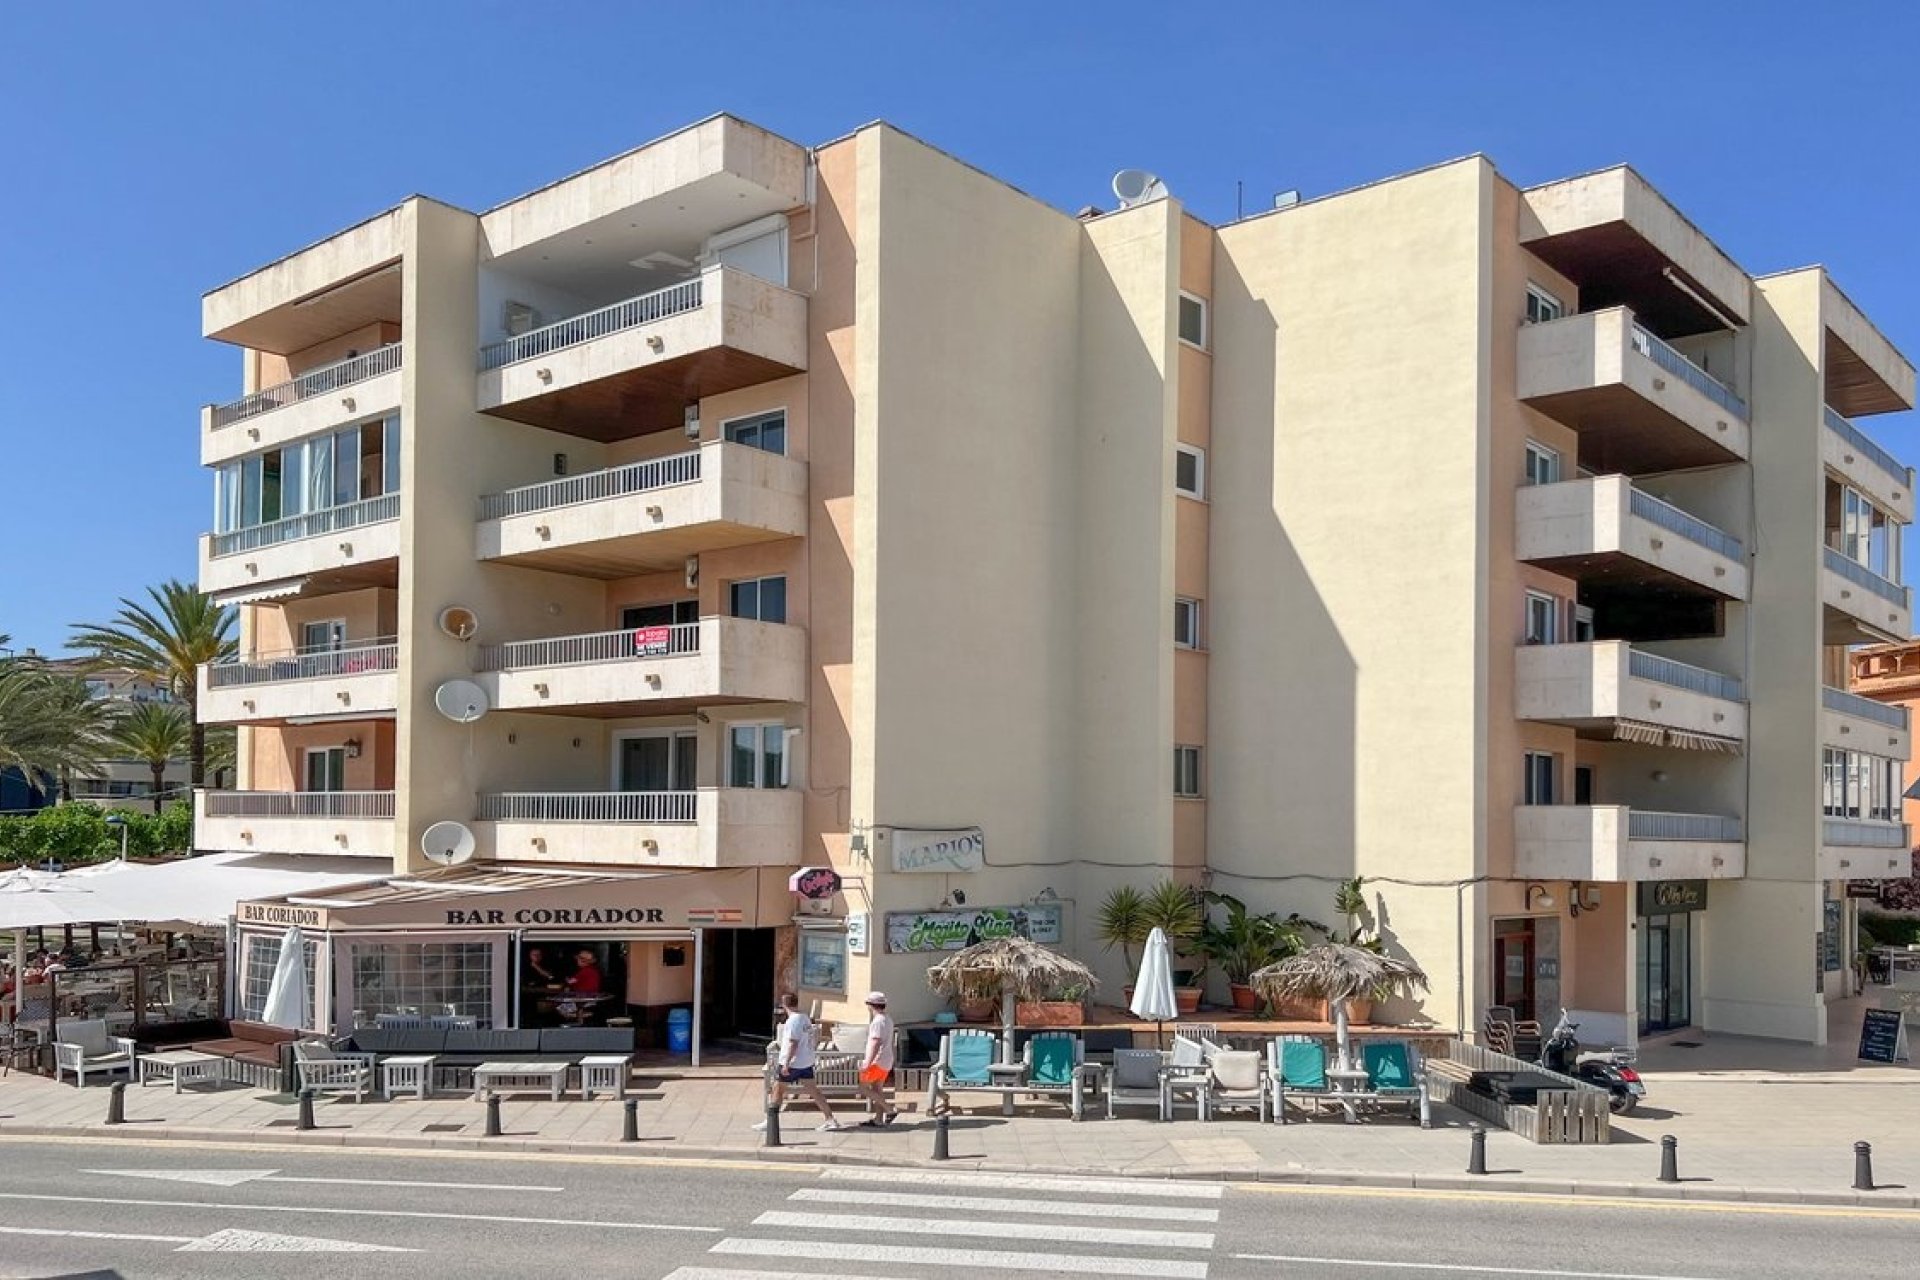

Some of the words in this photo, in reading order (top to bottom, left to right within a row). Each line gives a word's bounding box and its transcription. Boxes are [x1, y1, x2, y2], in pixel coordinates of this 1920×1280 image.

[244, 906, 264, 920] BAR
[266, 908, 319, 925] CORIADOR
[447, 910, 504, 924] BAR
[514, 908, 664, 924] CORIADOR
[909, 917, 968, 949] Mojito
